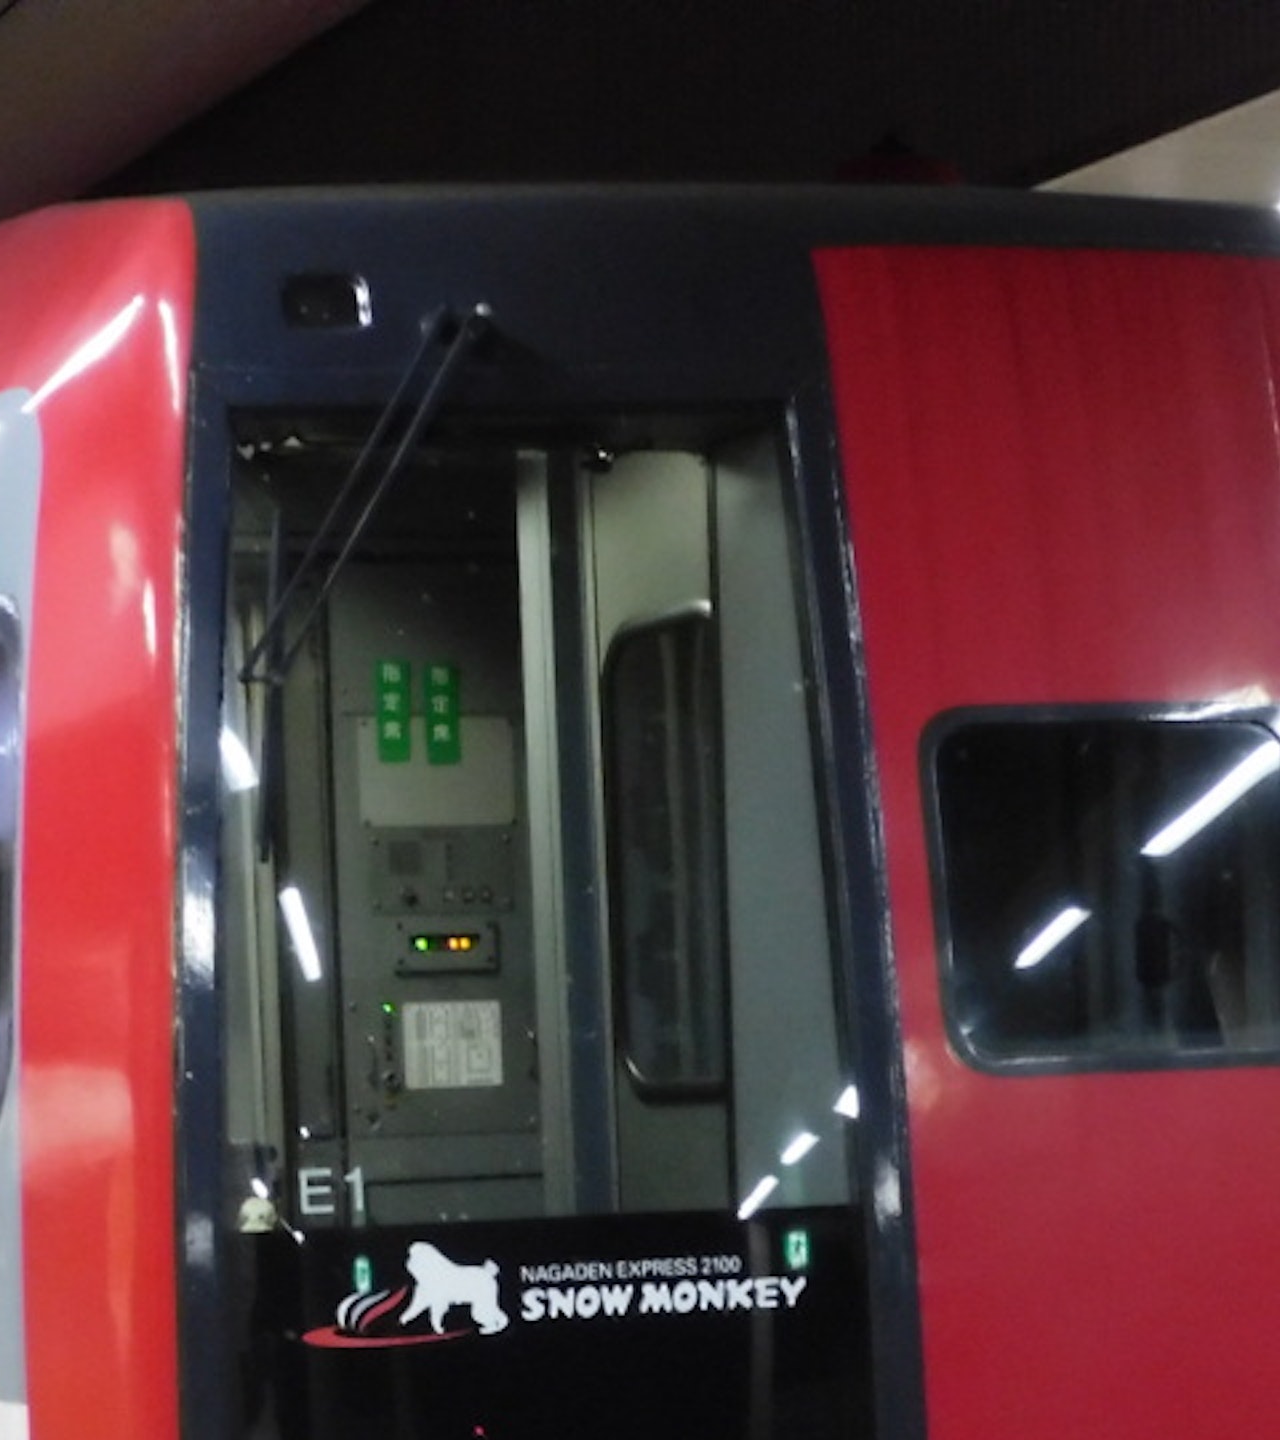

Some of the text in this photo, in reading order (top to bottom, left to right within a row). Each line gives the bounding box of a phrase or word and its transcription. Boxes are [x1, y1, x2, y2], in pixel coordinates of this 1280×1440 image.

[298, 1166, 365, 1215] E1
[520, 1254, 742, 1284] NAGADEN EXPRESS 2100
[521, 1275, 808, 1322] SNOW MONKEY
